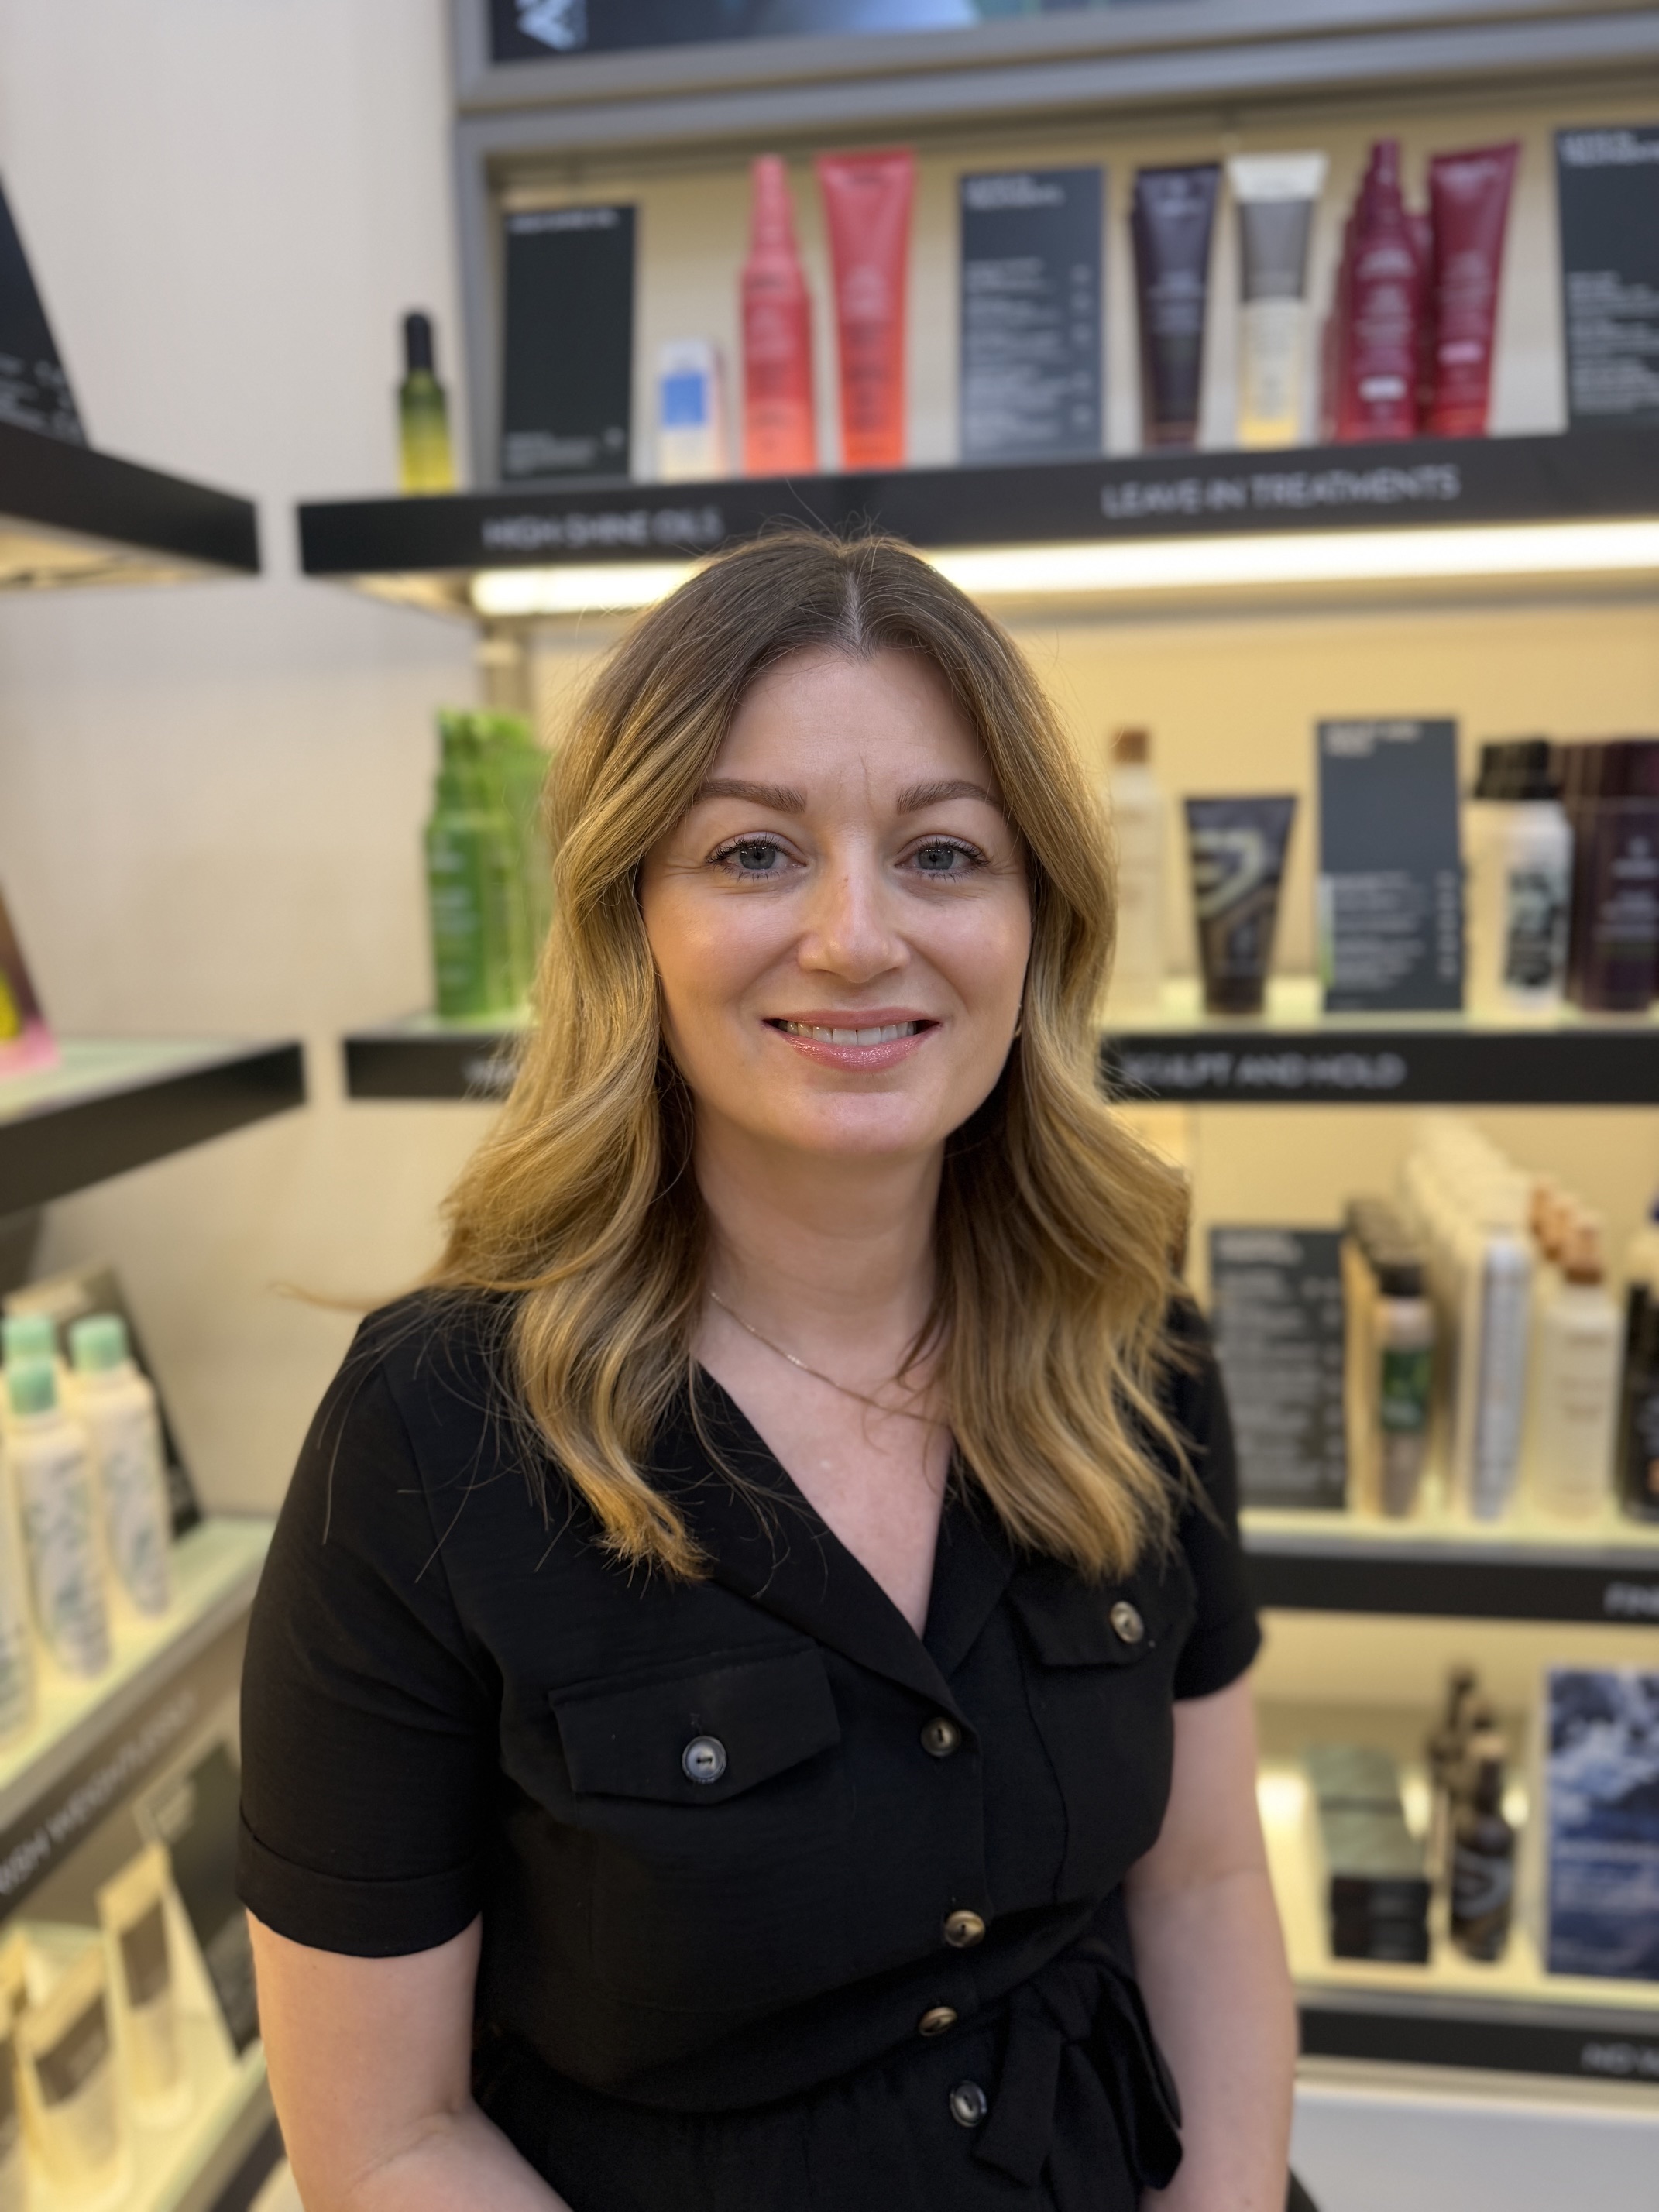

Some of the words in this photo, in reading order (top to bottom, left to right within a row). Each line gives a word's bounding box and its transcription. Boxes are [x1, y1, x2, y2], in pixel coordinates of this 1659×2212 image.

[1101, 479, 1202, 518] LEAVE
[1249, 465, 1461, 509] TREATMENTS
[482, 517, 562, 551] HIGH
[565, 513, 647, 548] SHINE
[1236, 1052, 1309, 1087] AND
[1310, 1052, 1407, 1087] HOLD
